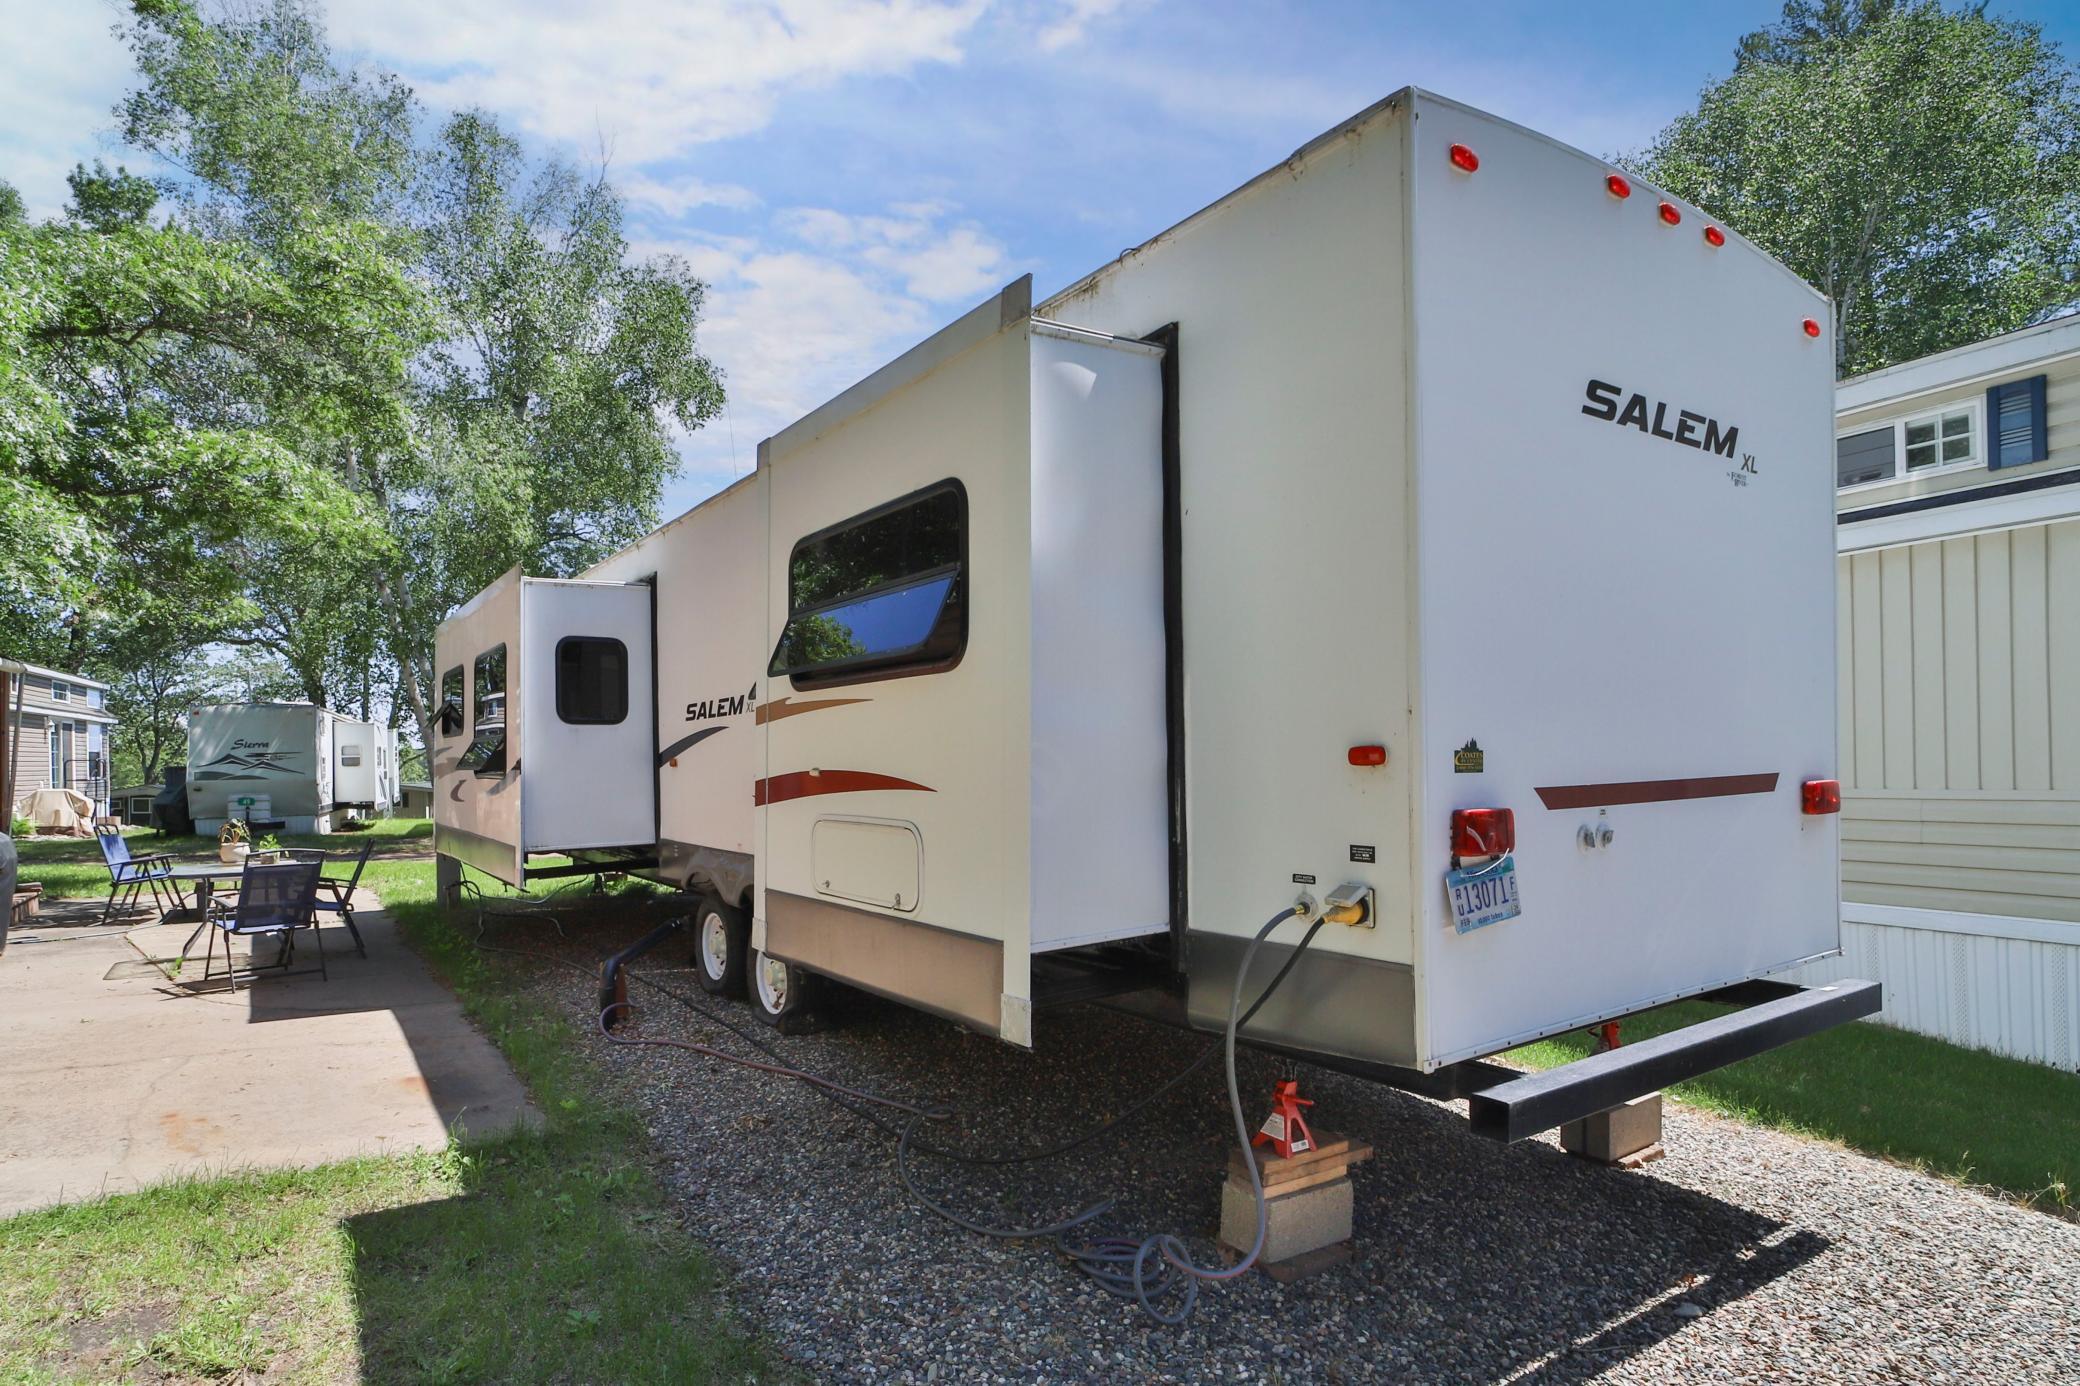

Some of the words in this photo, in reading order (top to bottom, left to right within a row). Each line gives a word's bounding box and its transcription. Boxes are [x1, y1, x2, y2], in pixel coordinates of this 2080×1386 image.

[1581, 378, 1739, 459] SALEM
[1740, 453, 1758, 474] XL
[685, 694, 745, 721] SALEM
[745, 701, 756, 713] XL
[230, 739, 269, 750] Sierra
[1464, 876, 1509, 914] 13071
